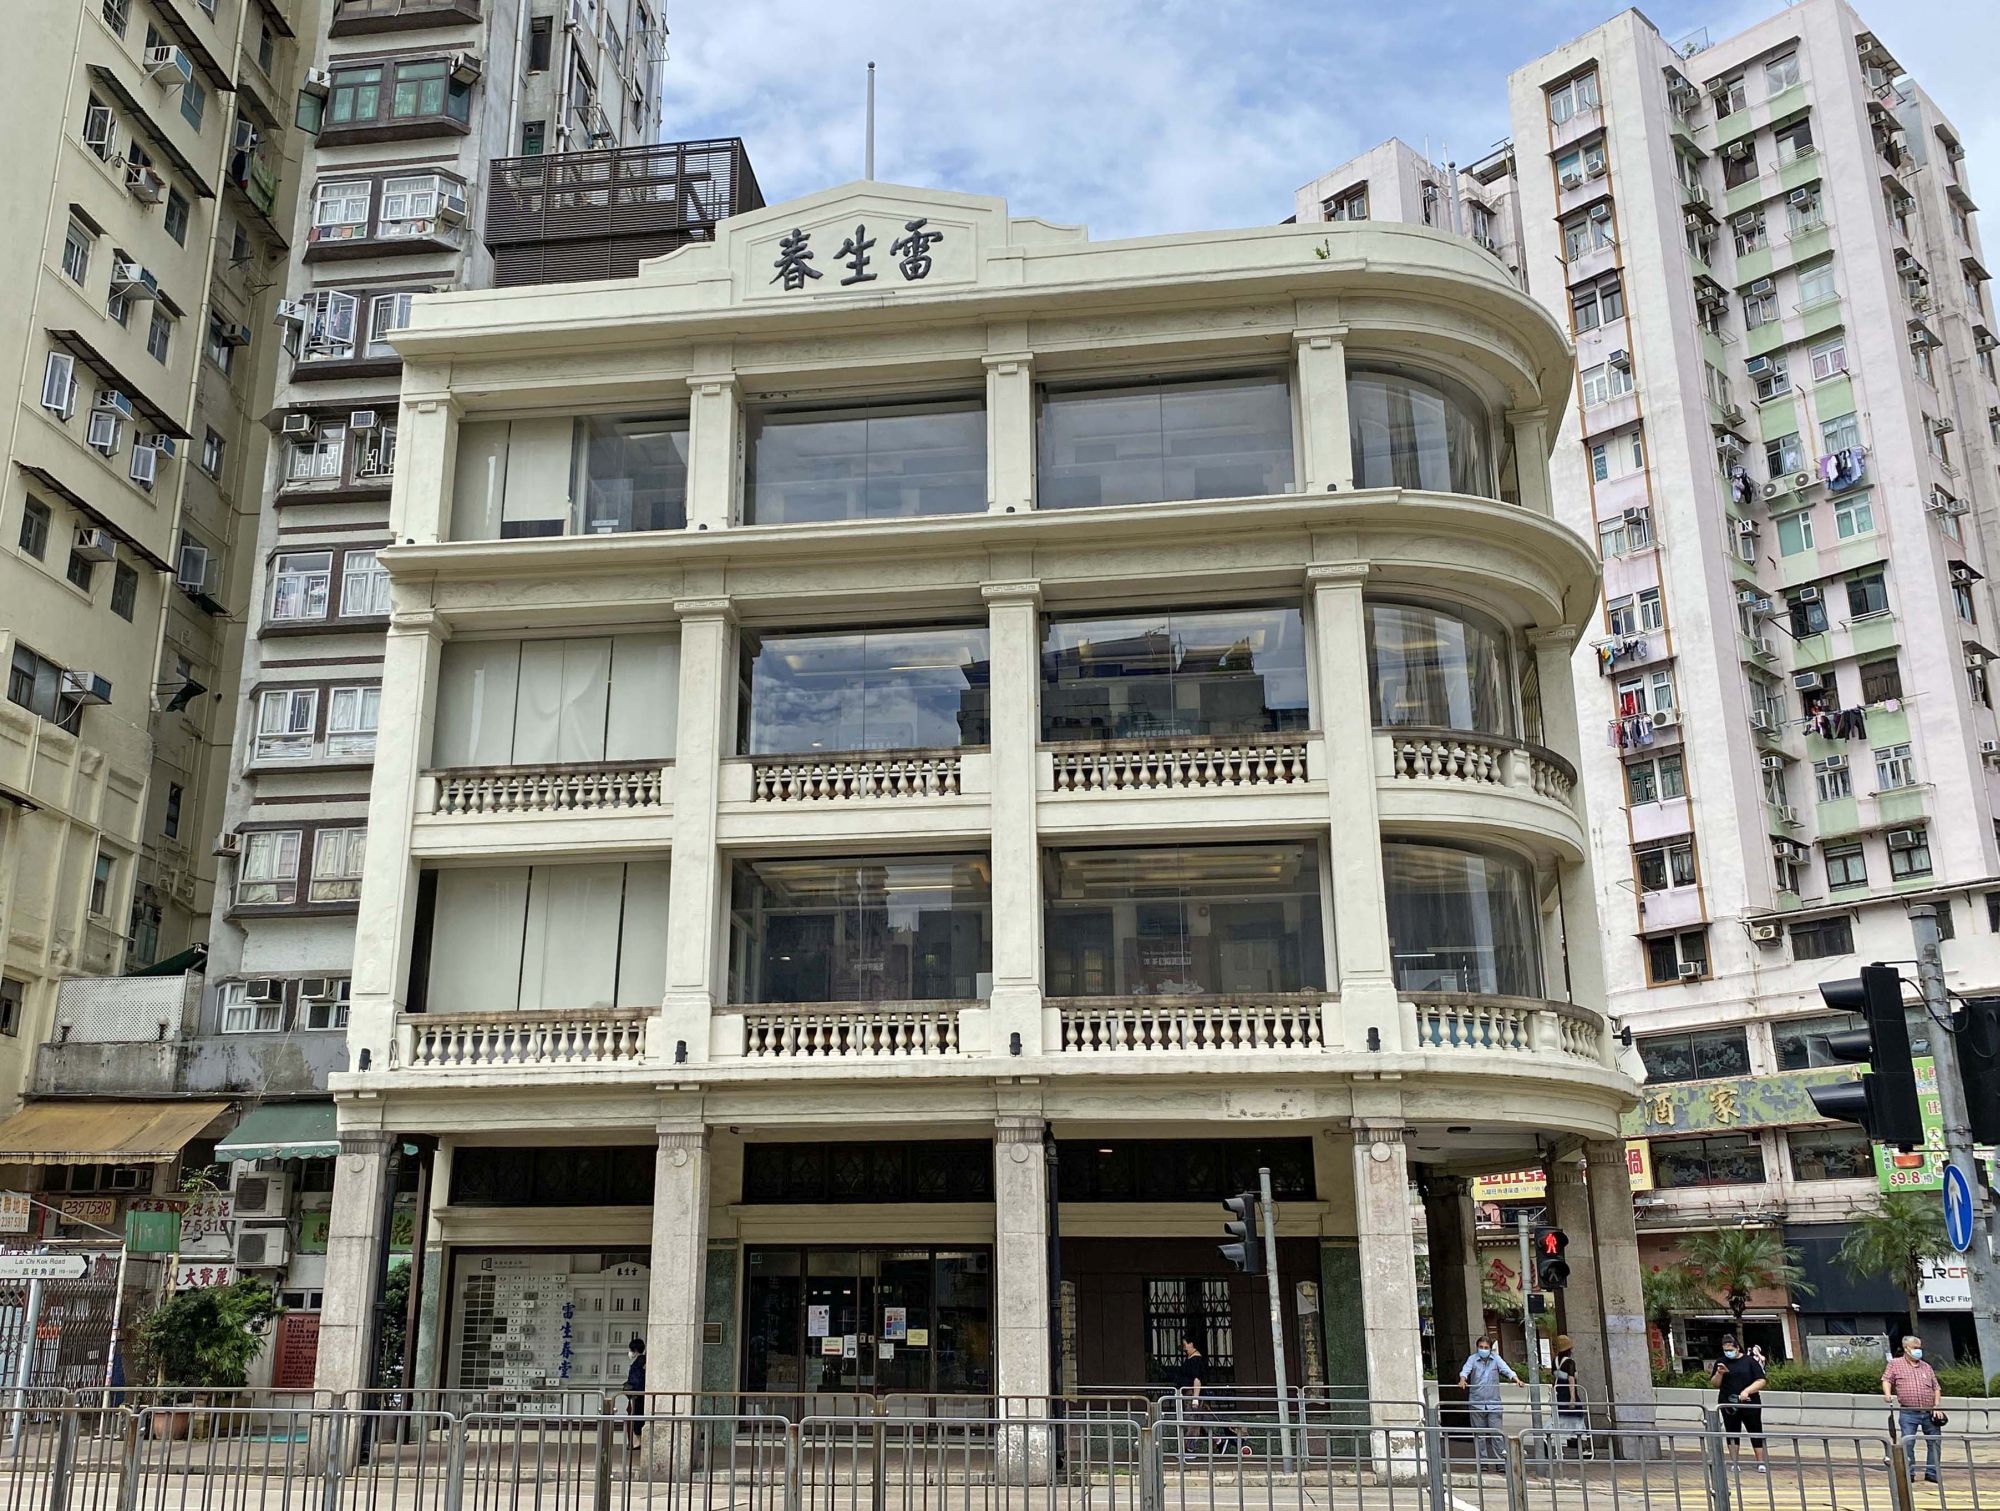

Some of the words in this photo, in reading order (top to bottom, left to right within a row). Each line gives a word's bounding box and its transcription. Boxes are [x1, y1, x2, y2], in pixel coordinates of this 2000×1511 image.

[1644, 1086, 1741, 1126] 酒家
[1890, 1171, 1920, 1185] $9.8
[64, 1200, 112, 1216] 23975318
[22, 1268, 56, 1276] 荔枝角道
[559, 1302, 576, 1379] 雷生春堂
